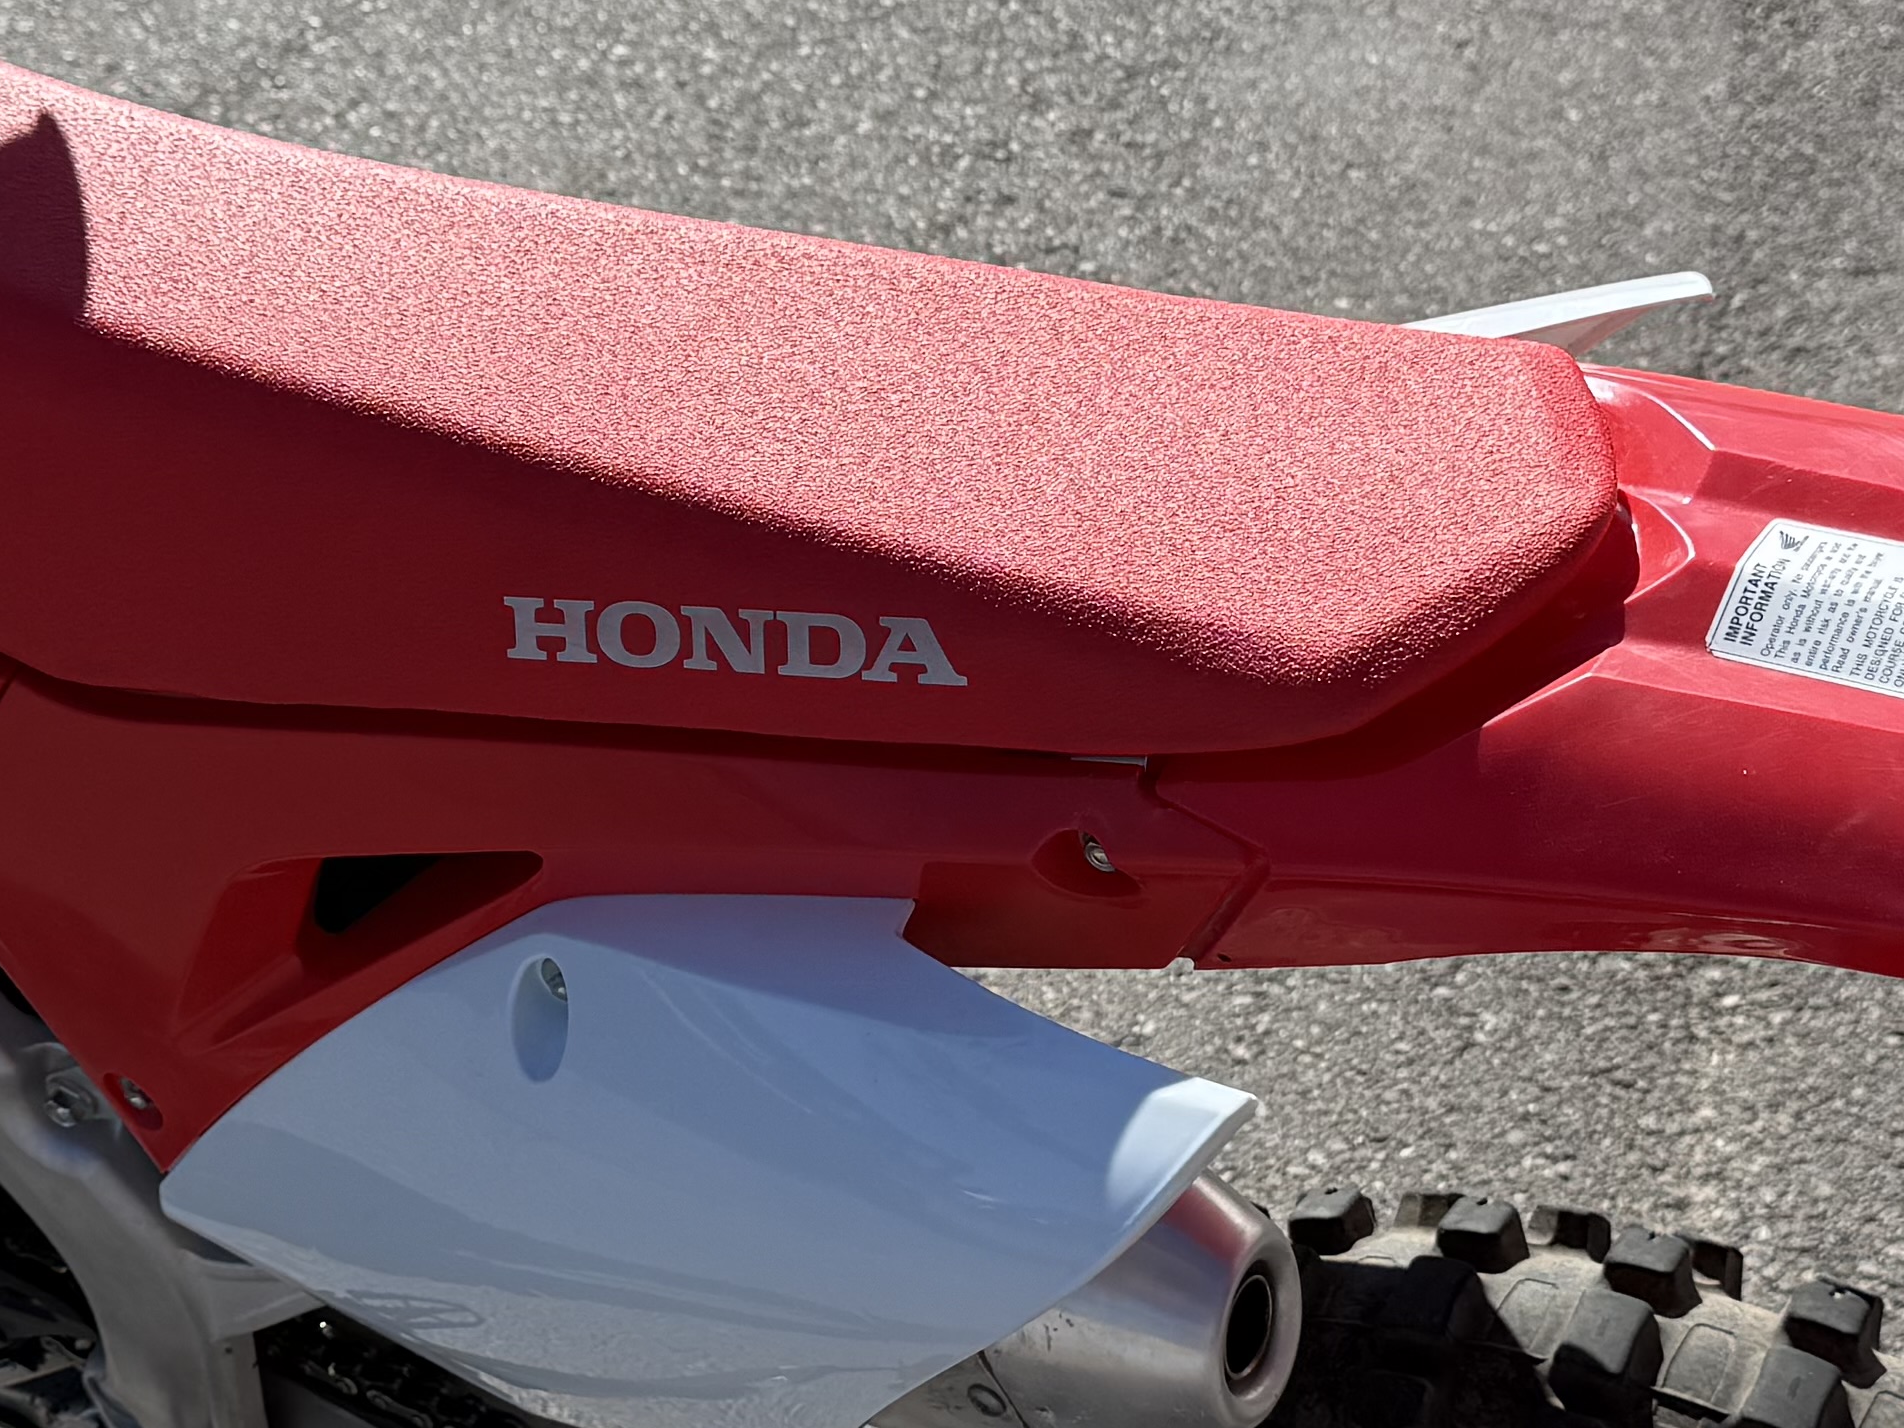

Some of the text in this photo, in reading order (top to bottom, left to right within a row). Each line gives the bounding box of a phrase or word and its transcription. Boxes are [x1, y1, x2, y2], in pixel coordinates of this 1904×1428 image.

[1723, 562, 1766, 642] IMPORTANT
[1739, 558, 1791, 646] INFORMATION
[1773, 639, 1790, 658] This
[1784, 604, 1806, 634] Honda
[1802, 599, 1823, 632] without
[1848, 652, 1867, 676] THIS
[1861, 585, 1898, 648] MOTORCYCLE
[1888, 601, 1904, 622] FOR
[503, 595, 968, 686] HONDA
[1804, 639, 1821, 666] entire
[1817, 618, 1831, 634] risk
[1818, 611, 1849, 670] performance
[1830, 647, 1850, 673] Read
[1845, 607, 1867, 643] owner's
[1878, 639, 1904, 683] COURSE
